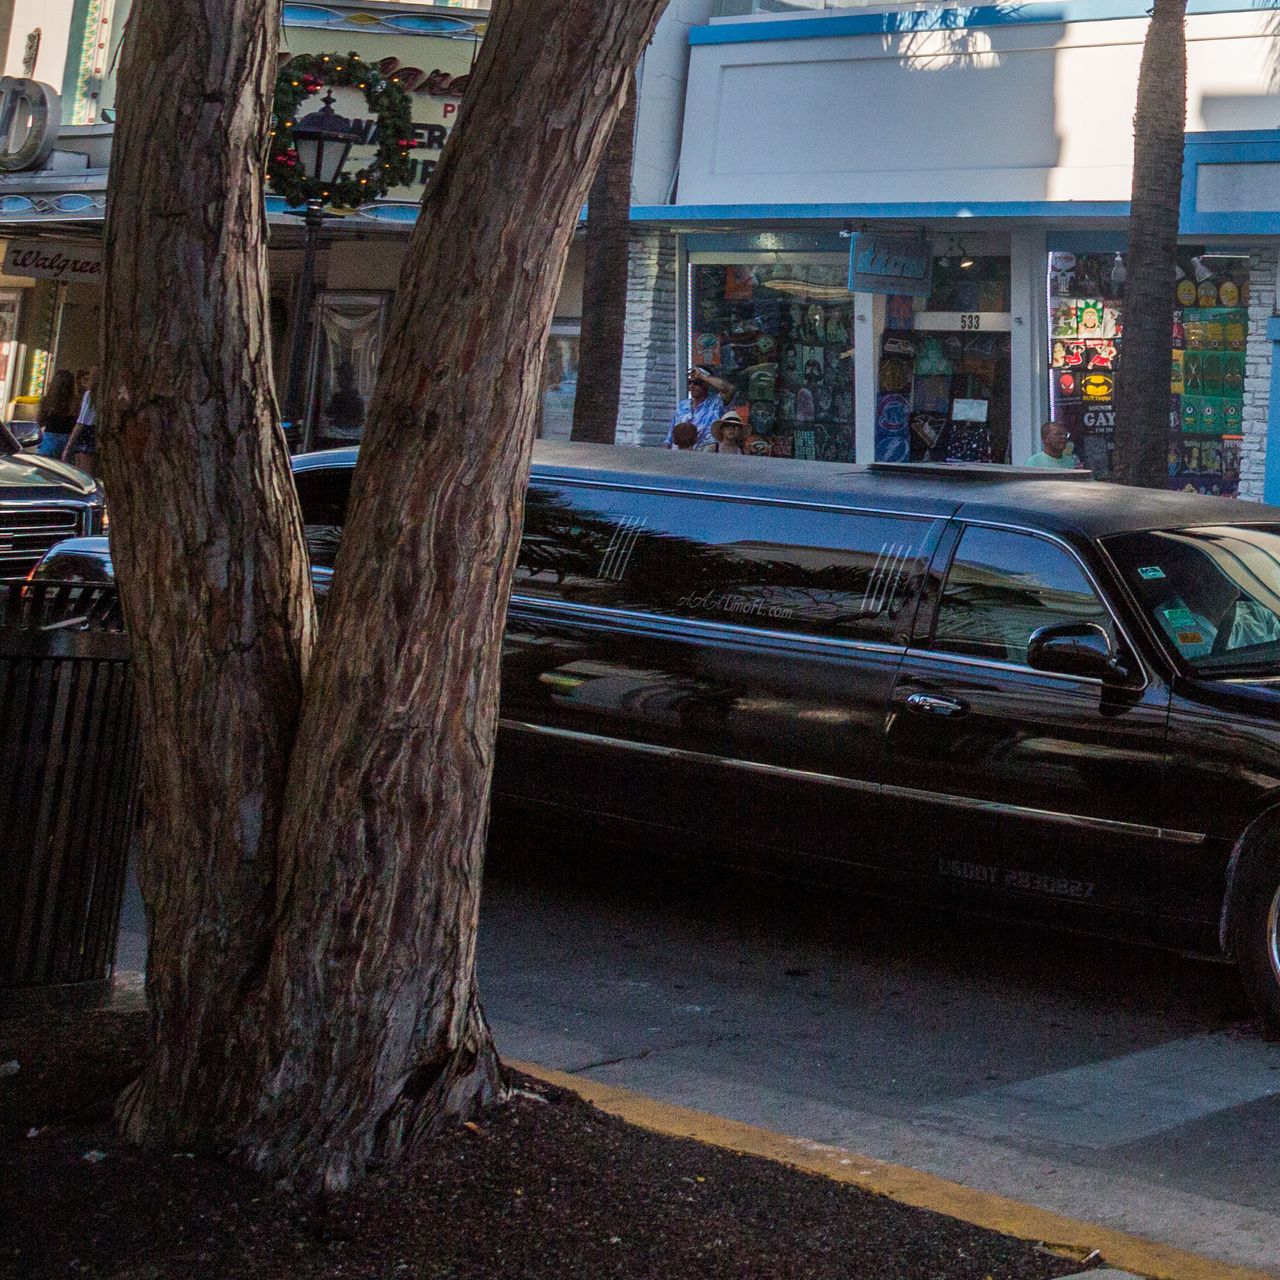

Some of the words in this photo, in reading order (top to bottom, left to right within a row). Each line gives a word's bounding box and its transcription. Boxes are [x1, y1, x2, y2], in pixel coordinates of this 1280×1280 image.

[11, 246, 102, 277] Walgree
[961, 314, 980, 330] 533
[1083, 412, 1116, 427] GAY
